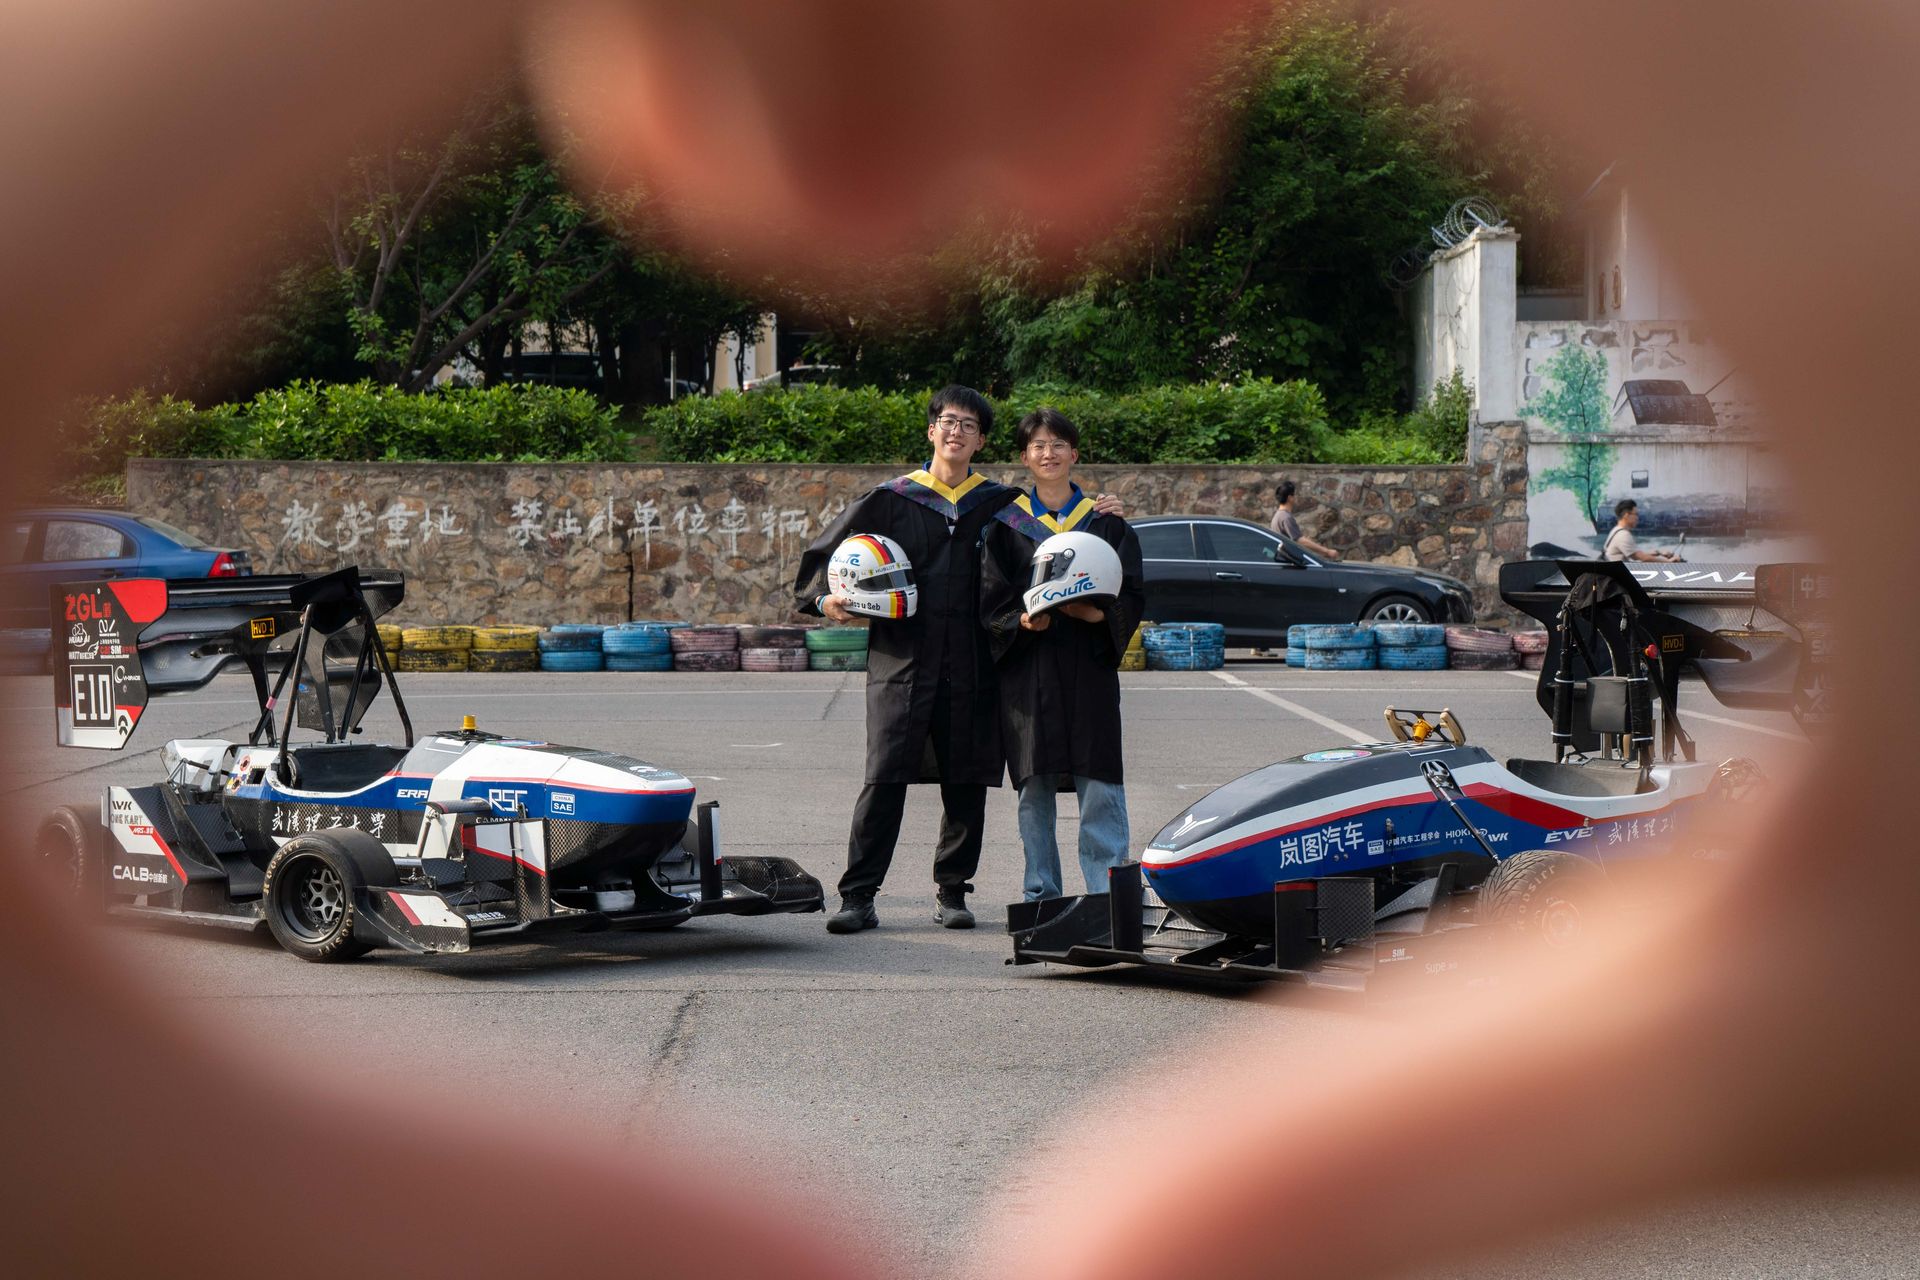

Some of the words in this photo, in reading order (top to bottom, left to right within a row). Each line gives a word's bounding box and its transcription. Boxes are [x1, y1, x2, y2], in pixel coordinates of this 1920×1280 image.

[867, 602, 880, 610] Seb
[74, 674, 112, 720] E10
[397, 789, 429, 799] ERA
[553, 802, 572, 811] SAE
[124, 815, 143, 825] KART
[1544, 827, 1594, 844] EVE
[1280, 821, 1365, 869] 岚图汽车
[113, 865, 149, 882] CALB
